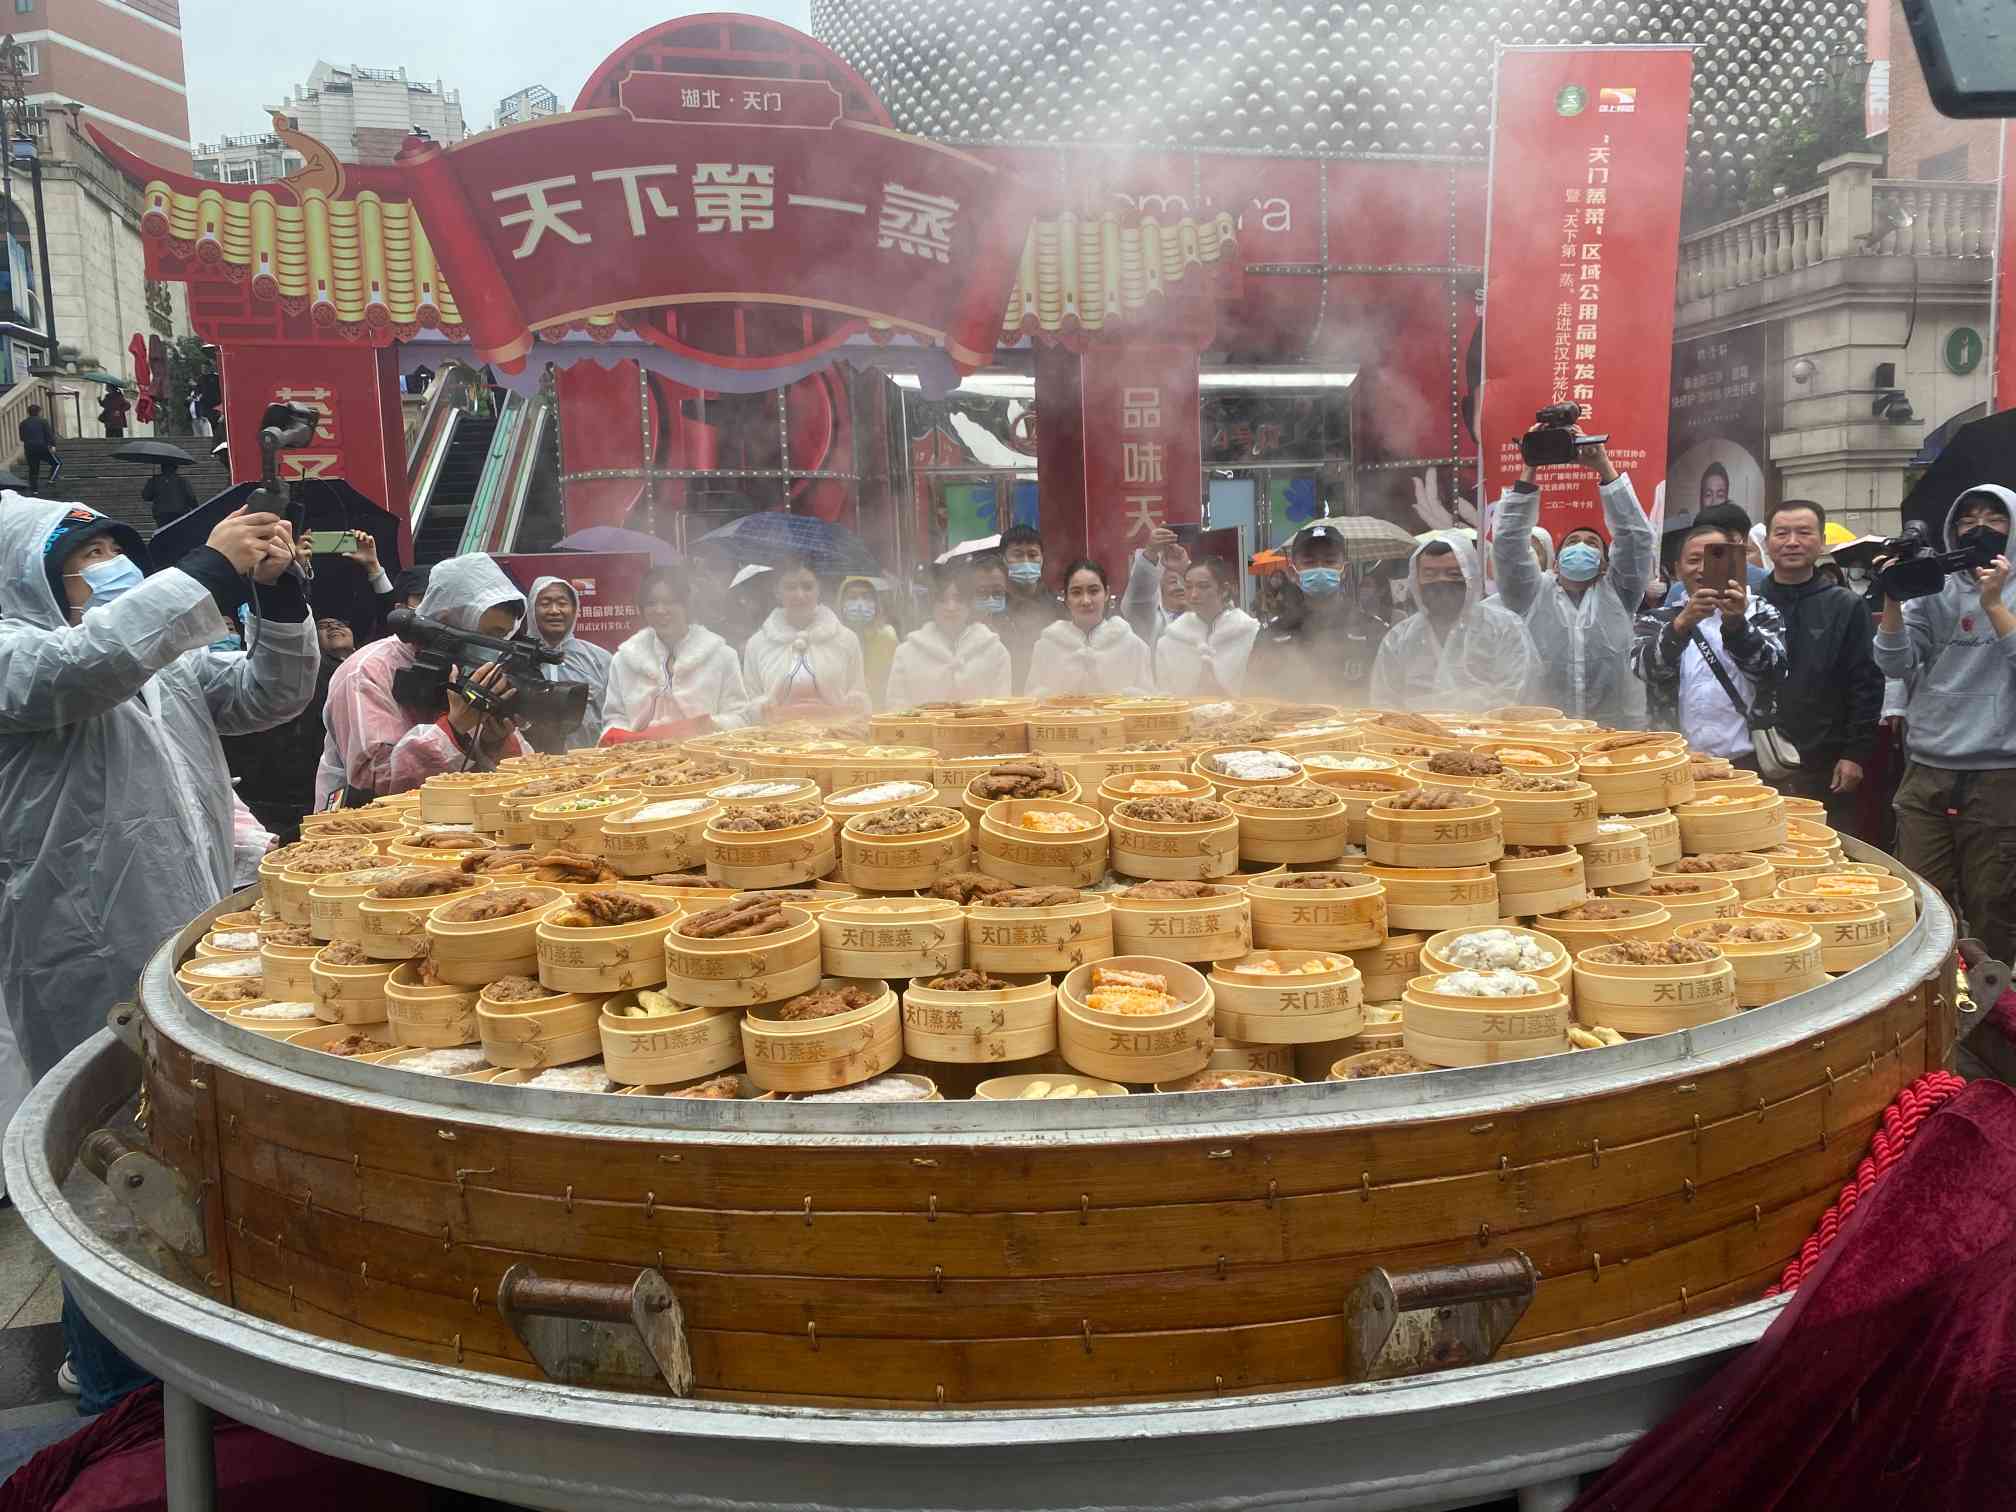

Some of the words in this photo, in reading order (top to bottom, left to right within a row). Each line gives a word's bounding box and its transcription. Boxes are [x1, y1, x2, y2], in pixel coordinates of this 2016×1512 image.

[491, 163, 961, 264] 天下第一蒸
[1121, 387, 1164, 537] 品味天
[842, 927, 913, 948] 天门蒸菜
[981, 925, 1048, 945] 天门蒸菜
[1150, 914, 1221, 938] 天门蒸菜
[1280, 985, 1349, 1012] 天门蒸菜
[1653, 976, 1728, 1002] 天门蒸菜
[906, 1004, 963, 1031] 天门蒸菜
[631, 1025, 708, 1052] 天门蒸菜
[755, 1038, 826, 1060] 天门蒸菜
[1110, 1031, 1187, 1051] 天门蒸菜
